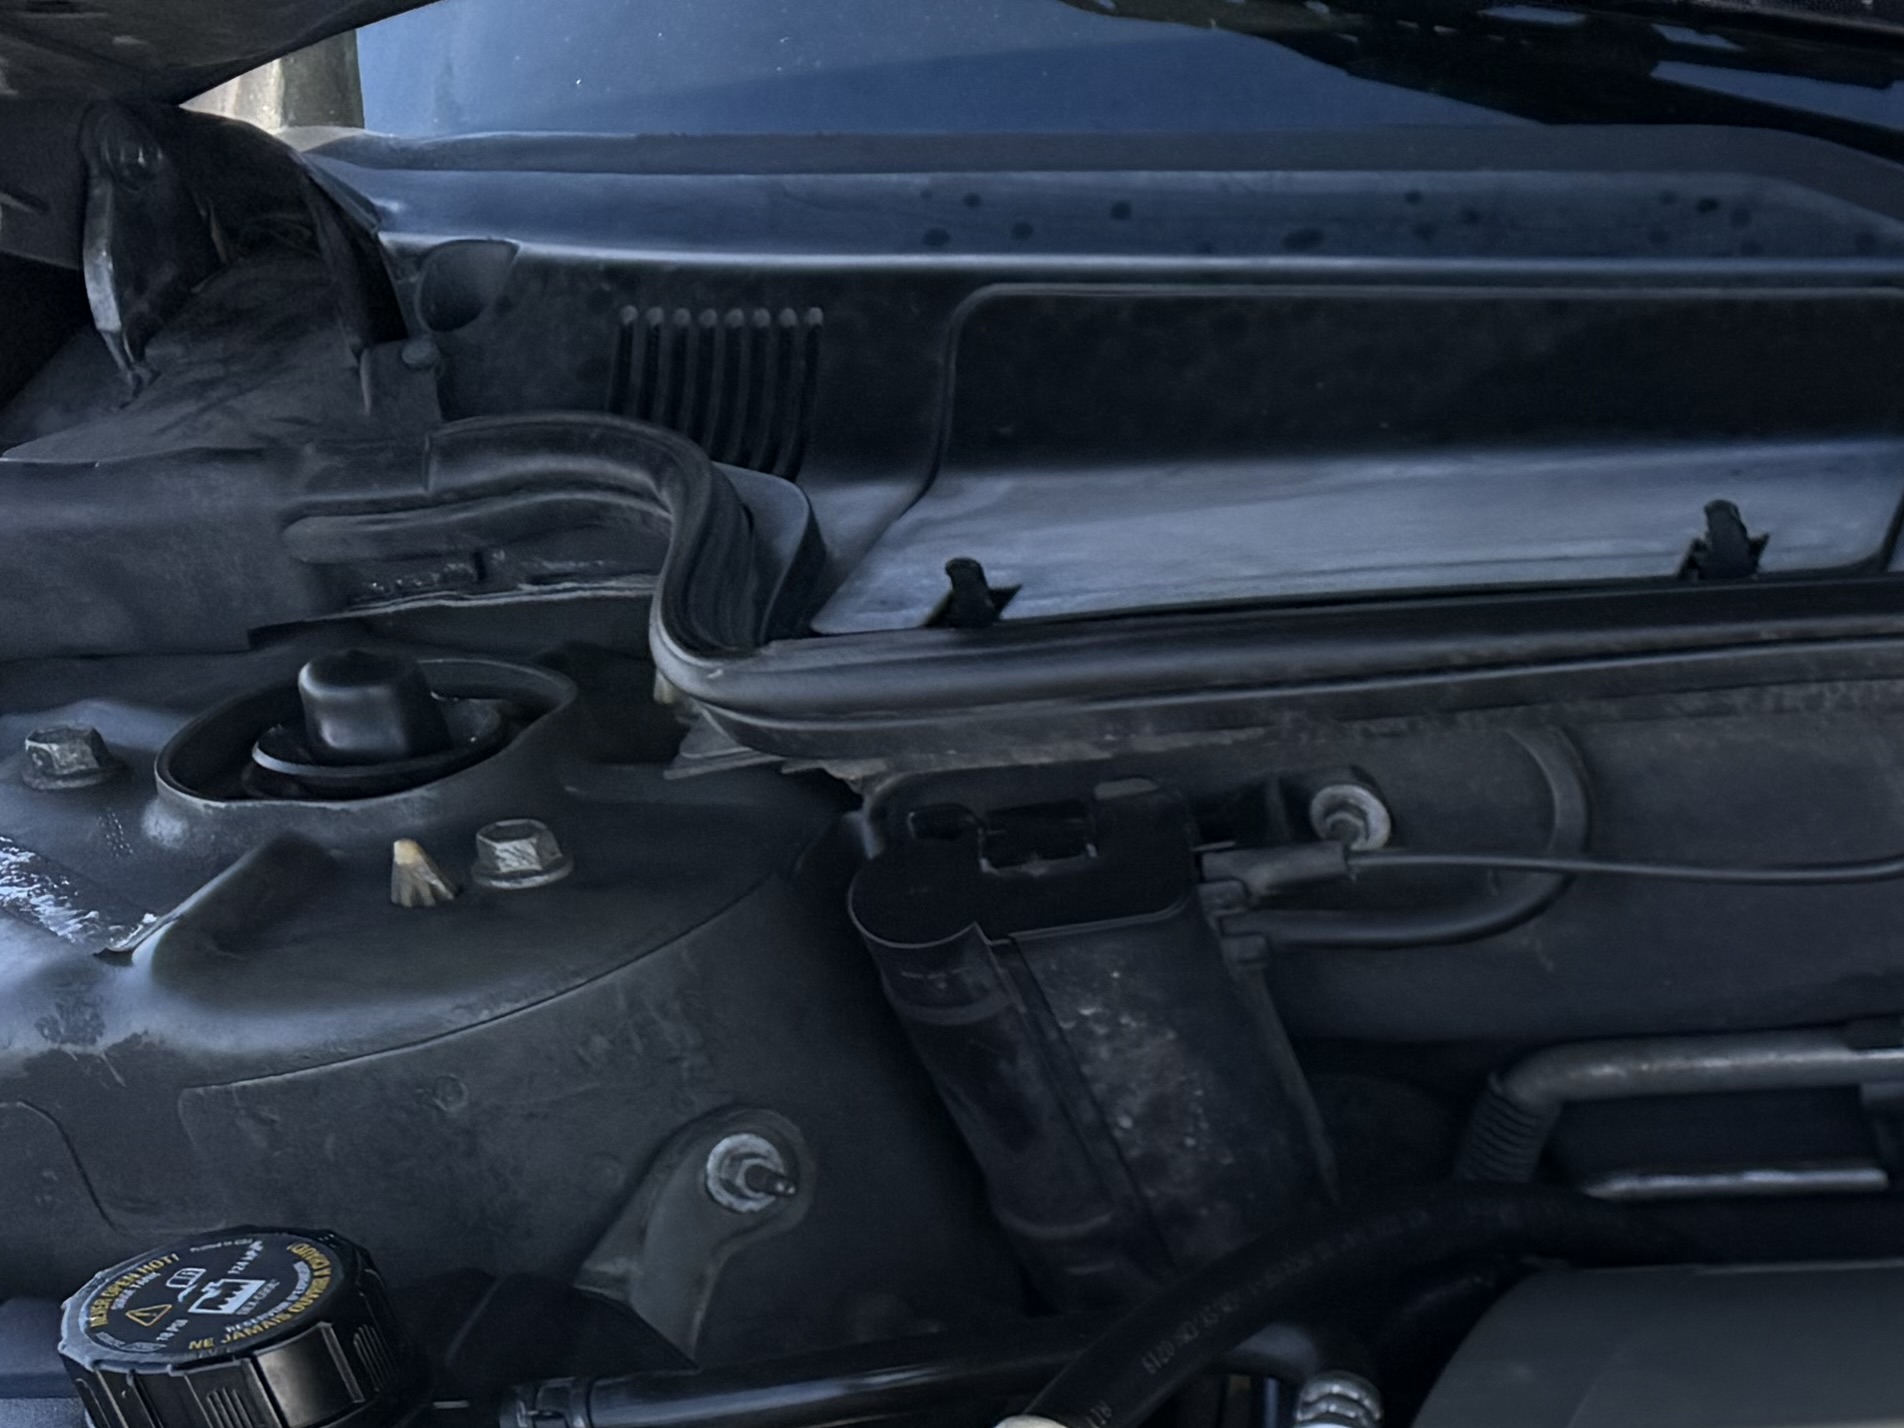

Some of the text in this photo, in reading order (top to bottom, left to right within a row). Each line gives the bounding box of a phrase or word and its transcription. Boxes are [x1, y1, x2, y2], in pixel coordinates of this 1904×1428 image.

[101, 1273, 141, 1299] OPEN
[189, 1337, 216, 1350] NE
[221, 1312, 293, 1344] JAMAIS
